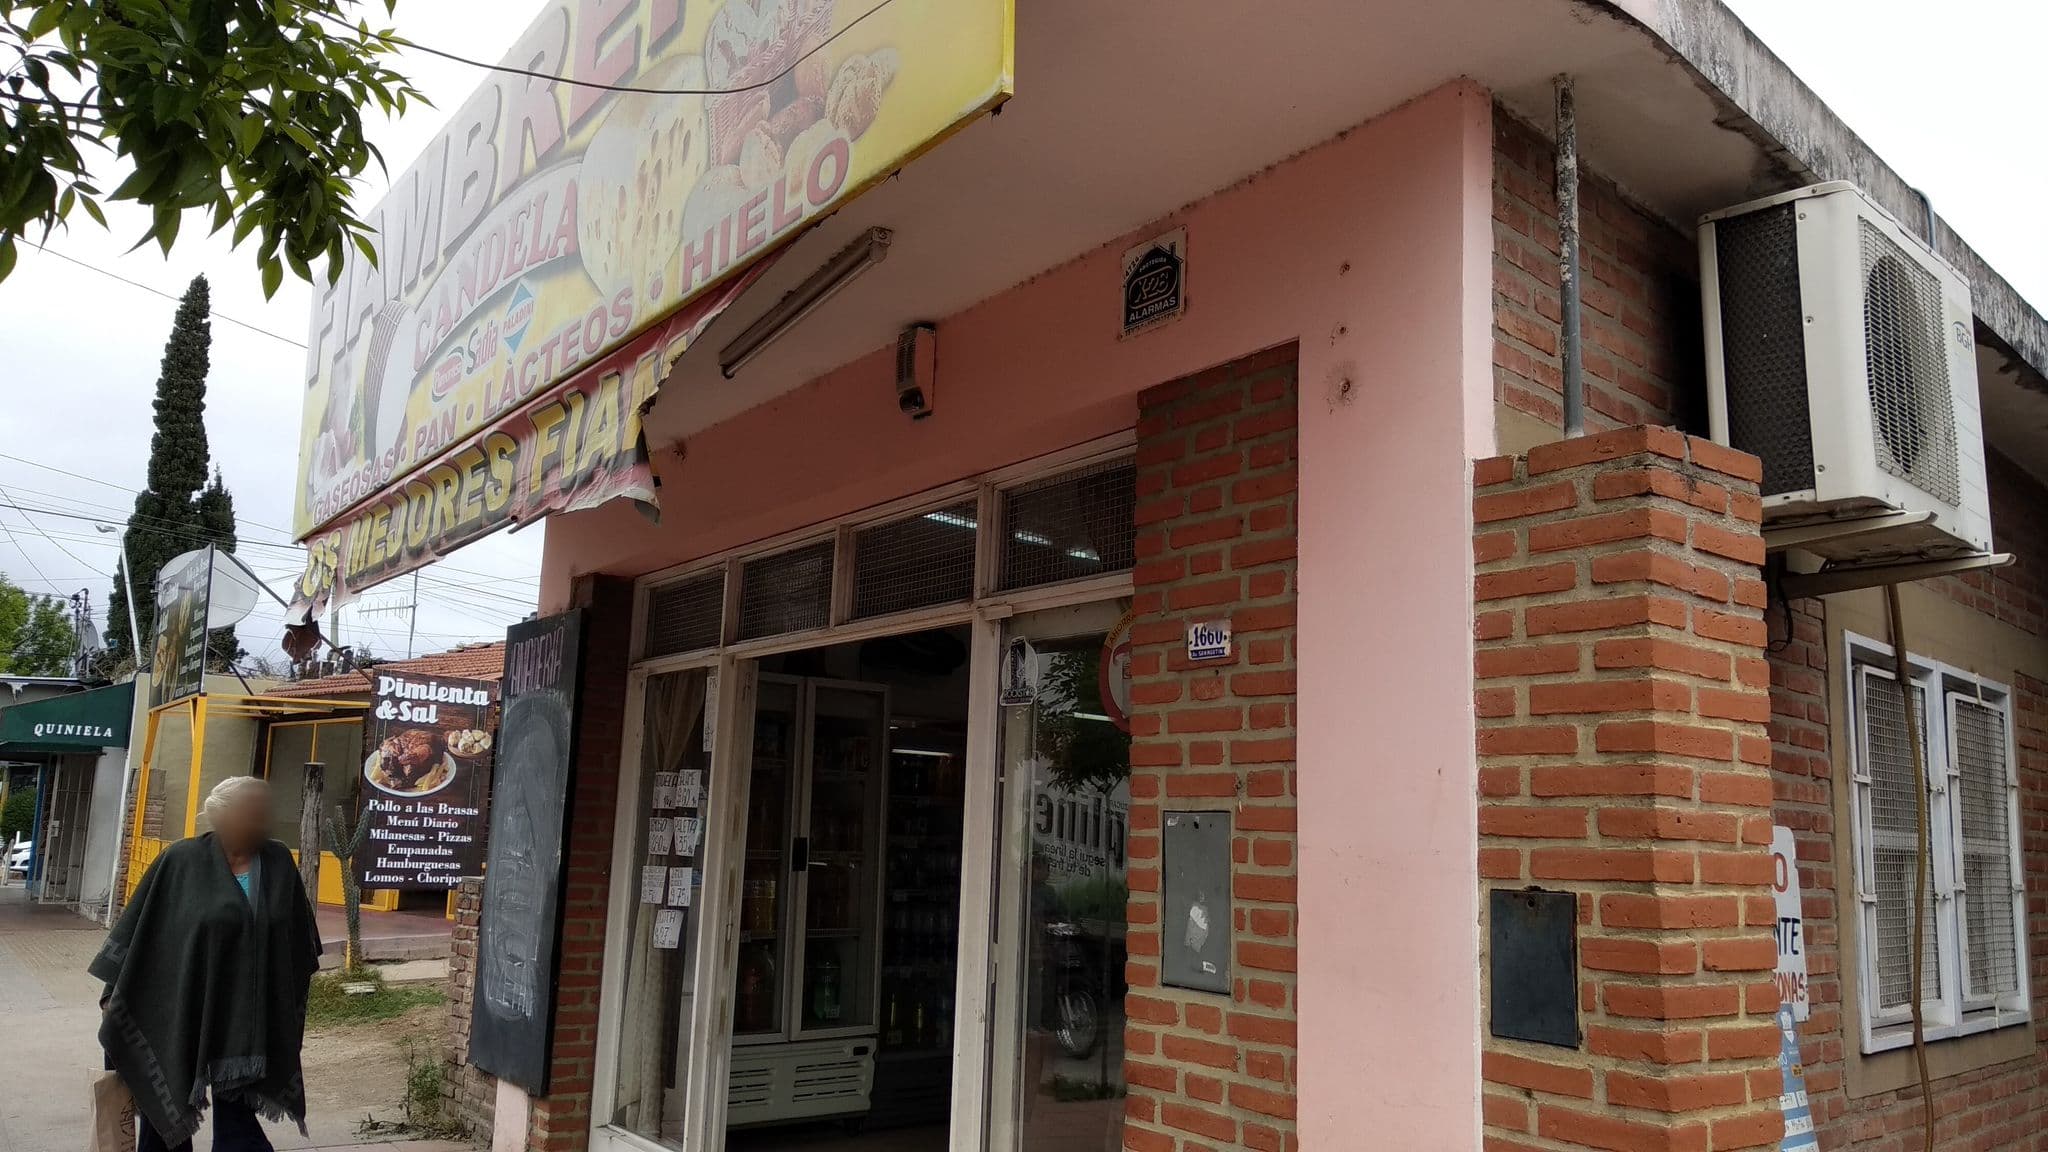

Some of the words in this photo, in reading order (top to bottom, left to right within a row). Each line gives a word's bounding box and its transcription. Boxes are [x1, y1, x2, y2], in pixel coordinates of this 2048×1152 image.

[307, 0, 688, 388] FIAMBRE
[413, 178, 578, 373] CANDELA
[1129, 297, 1176, 322] ALARMAS
[313, 447, 394, 525] GASEOSAS
[415, 403, 457, 463] PAN
[681, 137, 850, 295] HIELO
[1956, 327, 1973, 353] BGH
[346, 430, 519, 578] MEJORES
[1193, 625, 1223, 647] 1660
[377, 675, 490, 706] Pimienta
[34, 723, 112, 737] QUINIELA
[368, 799, 401, 812] Pollo
[405, 805, 412, 813] a
[416, 802, 434, 814] las
[438, 803, 479, 816] Brasas
[386, 815, 419, 827] Menú
[423, 817, 459, 829] Diario
[369, 829, 426, 841] Milanesas
[438, 831, 473, 843] Pizzas
[387, 843, 453, 858] Empanadas
[376, 857, 461, 872] Hamburguesas
[364, 871, 405, 883] Lomos
[1775, 971, 1805, 1003] ONAS
